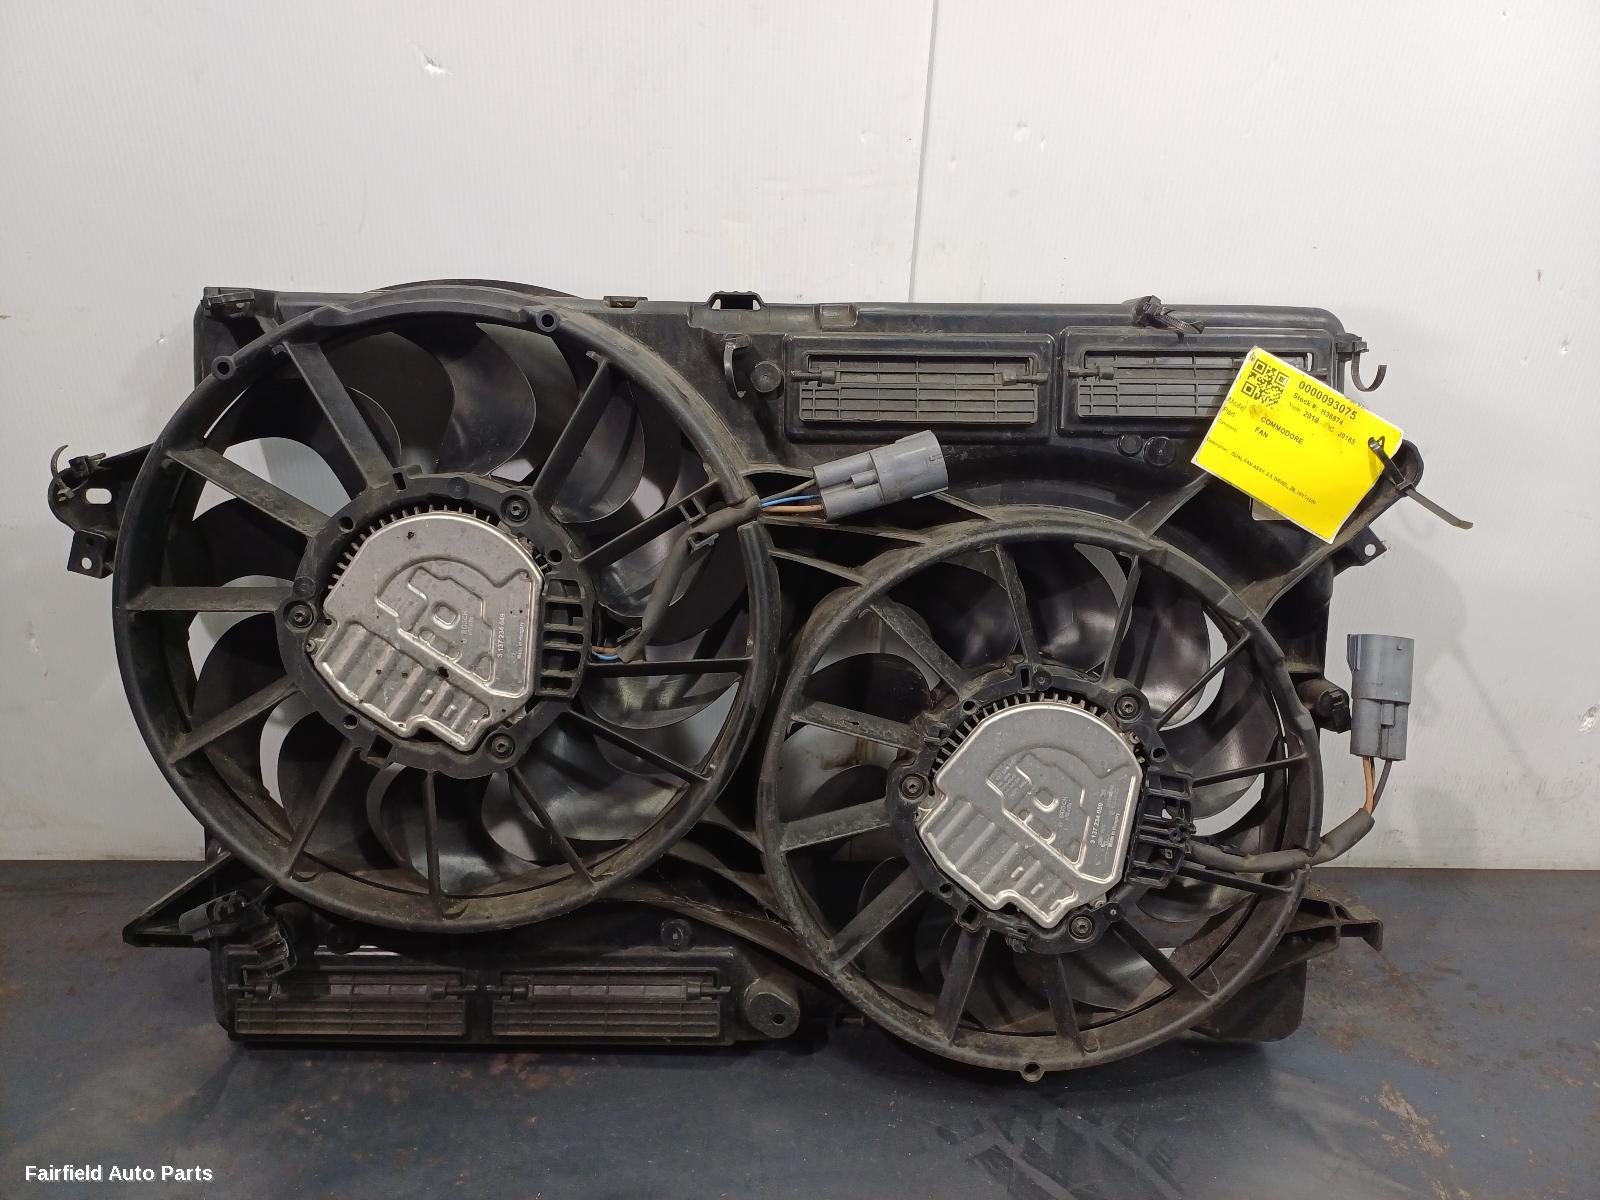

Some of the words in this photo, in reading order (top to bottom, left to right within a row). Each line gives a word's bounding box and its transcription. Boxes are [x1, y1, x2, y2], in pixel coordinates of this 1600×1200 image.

[1293, 393, 1311, 407] Stock
[1298, 380, 1358, 420] 0000093075
[1254, 426, 1269, 439] FAN
[1260, 416, 1305, 445] COMMODORE
[1059, 795, 1067, 818] BOSCH
